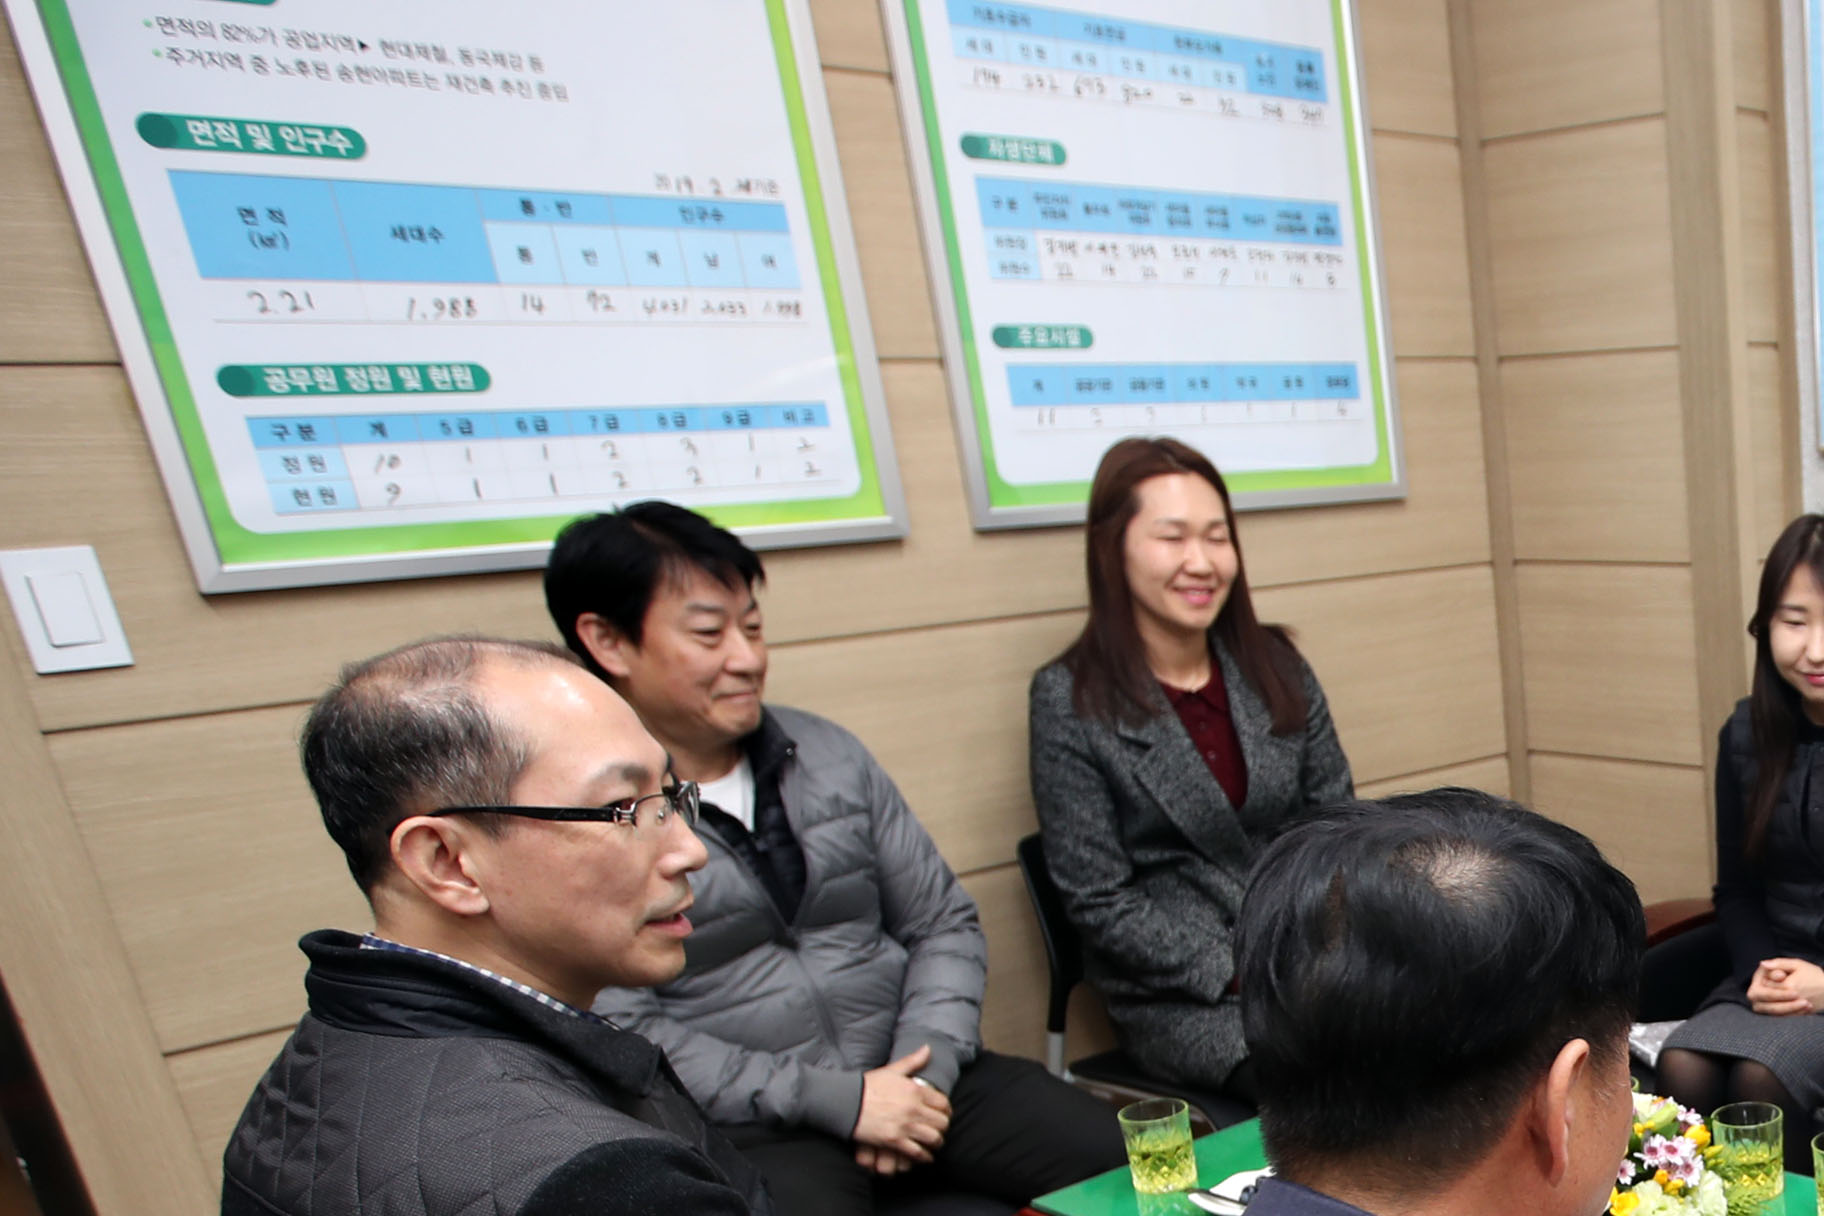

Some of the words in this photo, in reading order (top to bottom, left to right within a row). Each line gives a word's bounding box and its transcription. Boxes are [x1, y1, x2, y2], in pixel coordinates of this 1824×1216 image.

[156, 16, 217, 40] 면적의
[167, 47, 245, 71] 주거지역
[185, 118, 242, 150] 면적
[246, 122, 275, 152] 및
[279, 126, 354, 156] 인구수
[263, 366, 340, 393] 공무원
[344, 366, 394, 392] 정원
[397, 365, 424, 392] 및
[427, 365, 476, 391] 현원
